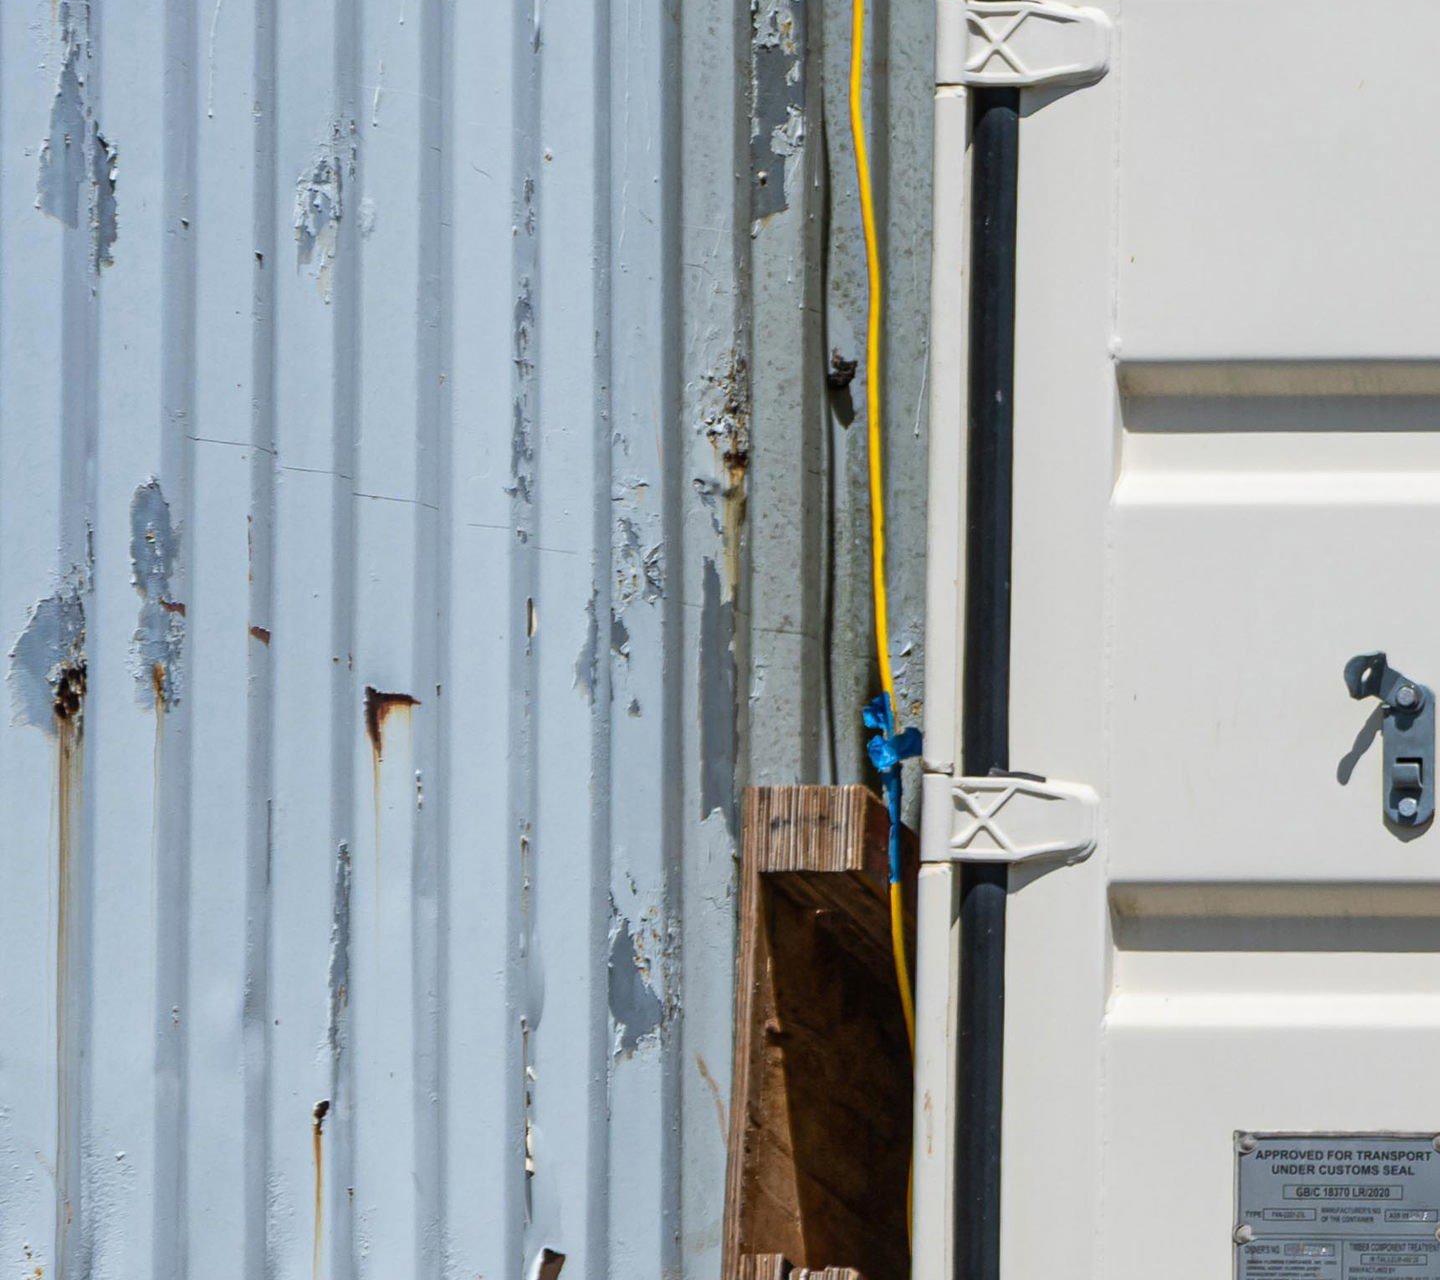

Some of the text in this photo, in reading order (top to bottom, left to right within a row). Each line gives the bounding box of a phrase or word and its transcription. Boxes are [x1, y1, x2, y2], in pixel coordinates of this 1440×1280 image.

[1255, 1150, 1433, 1162] APPROVED FOR TRANSPORT
[1271, 1164, 1415, 1176] UNDER CUSTOMS SEAL
